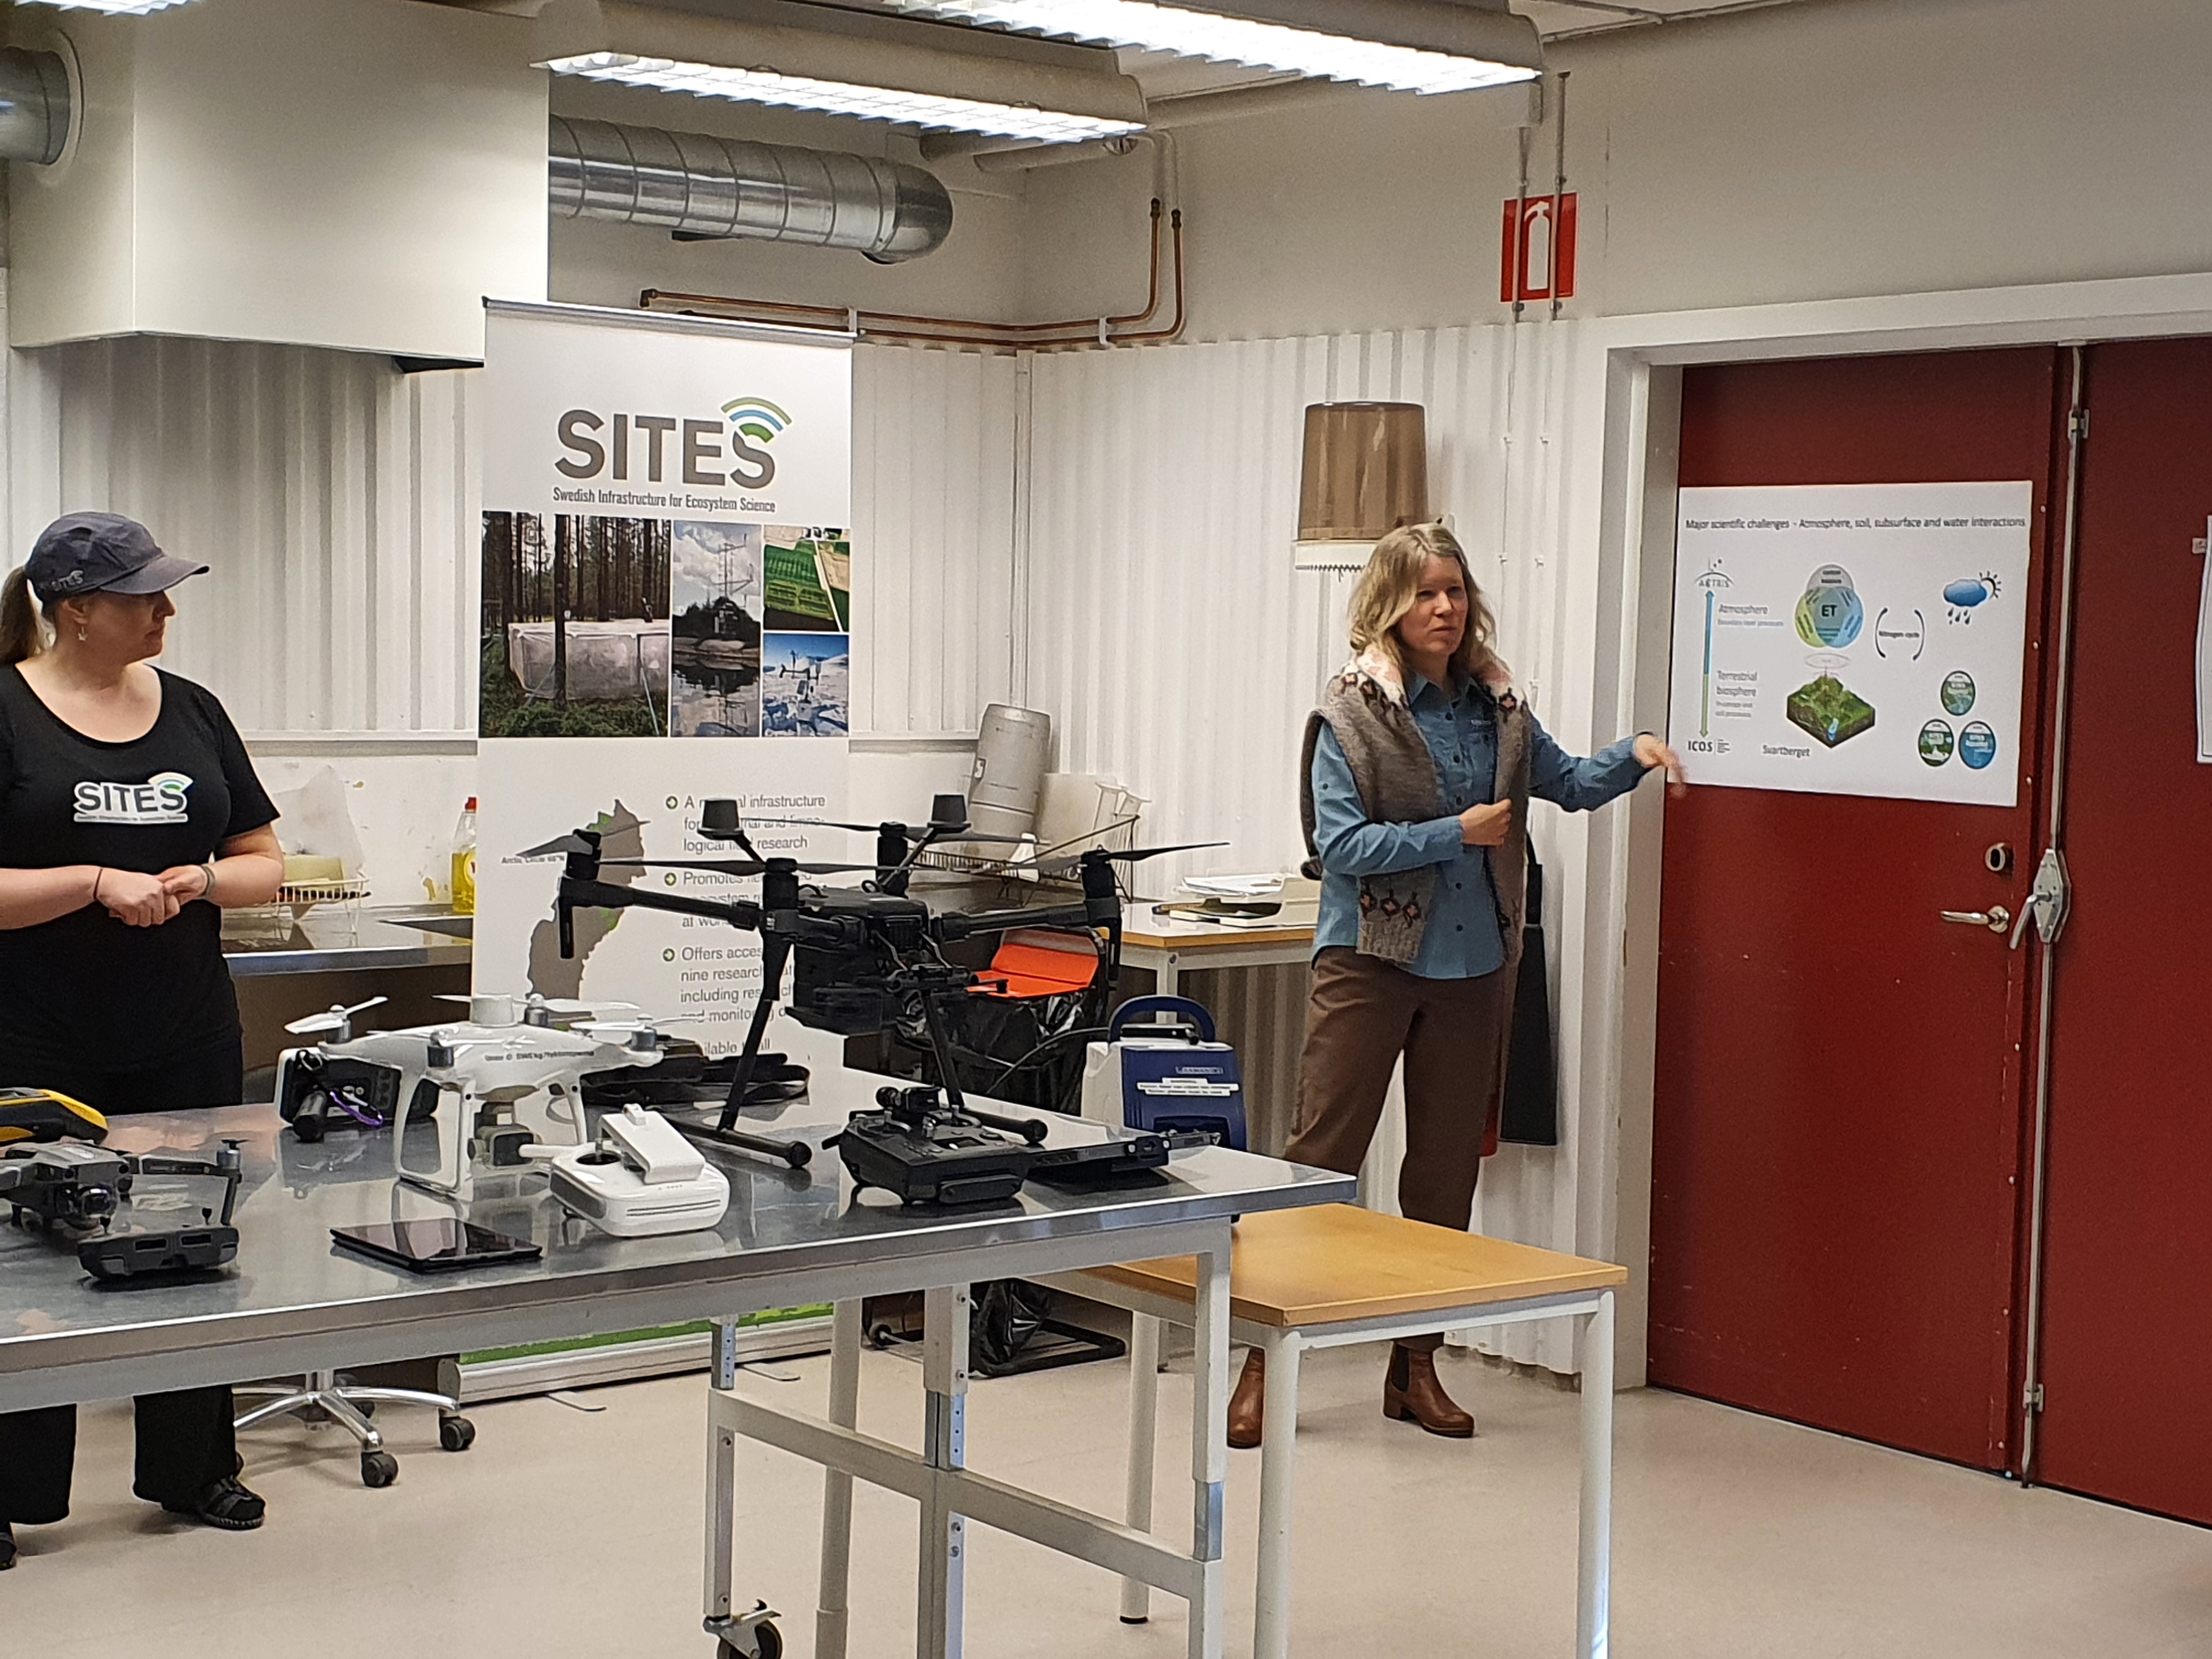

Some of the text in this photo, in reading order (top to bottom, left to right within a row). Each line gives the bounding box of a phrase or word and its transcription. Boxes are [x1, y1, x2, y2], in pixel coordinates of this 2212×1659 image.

[555, 409, 775, 489] SITES
[553, 487, 776, 512] Swedish Infrastructure for Ecosystem Science
[1686, 519, 1709, 531] Major
[1711, 518, 1745, 529] scientific
[1747, 518, 1789, 531] challenges
[1799, 519, 1853, 530] Atmosphere,
[1855, 517, 1872, 529] soil,
[1875, 517, 1921, 527] subsurface
[1923, 517, 1940, 527] and
[1943, 518, 1968, 527] water
[1971, 517, 2025, 527] interactions
[52, 572, 83, 592] SITES
[1718, 604, 1768, 614] Atmosphere
[1821, 605, 1837, 617] ET
[1717, 670, 1757, 681] Terrestrial
[1717, 686, 1756, 697] biosphere
[1688, 741, 1713, 752] ICOS
[77, 785, 188, 814] SITES
[685, 795, 695, 808] A
[750, 794, 825, 808] infrastructure
[684, 838, 725, 855] logical
[757, 835, 808, 849] research
[684, 871, 743, 885] Promotes
[682, 946, 723, 961] Offers
[681, 969, 708, 982] nine
[681, 988, 739, 1003] including
[704, 1041, 737, 1055] ilable
